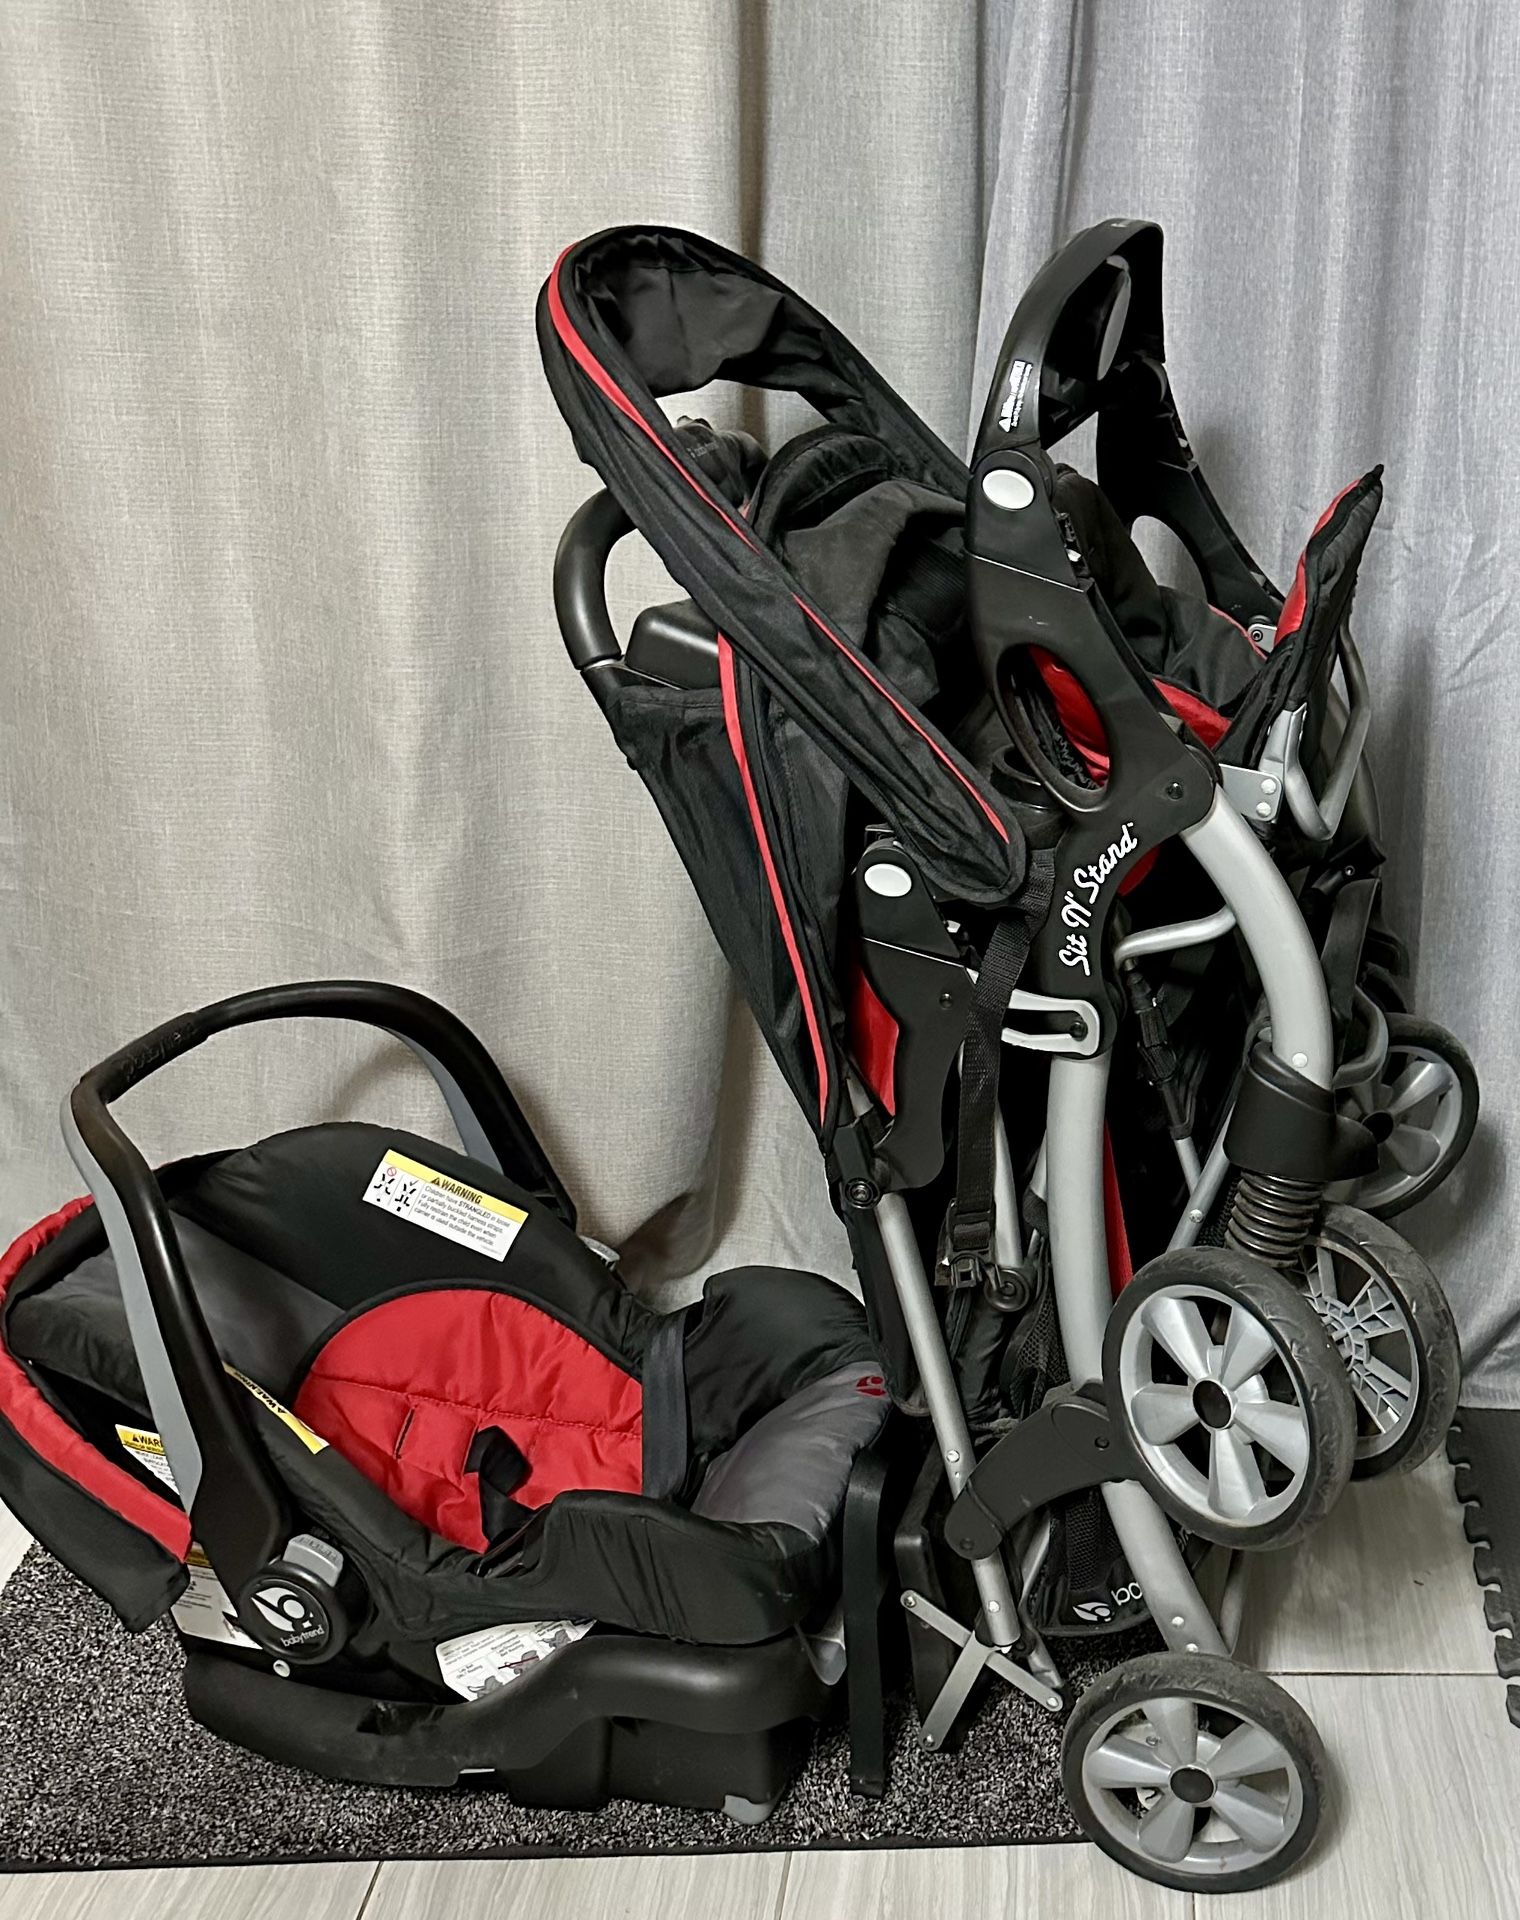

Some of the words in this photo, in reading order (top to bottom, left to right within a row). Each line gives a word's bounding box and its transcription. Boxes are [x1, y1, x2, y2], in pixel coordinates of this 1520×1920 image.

[1073, 823, 1138, 904] Stand
[1058, 933, 1091, 976] Sit
[425, 1185, 445, 1198] Children
[446, 1195, 457, 1203] have
[459, 1201, 490, 1218] STRANGLED
[441, 1179, 482, 1204] WARNING
[414, 1207, 430, 1217] carrier
[436, 1217, 448, 1225] used
[449, 1222, 467, 1233] outside
[418, 1200, 429, 1209] Fully
[430, 1206, 449, 1217] restrain
[458, 1218, 470, 1226] child
[471, 1224, 482, 1232] even
[483, 1229, 496, 1238] when
[427, 1195, 446, 1208] partially
[447, 1204, 464, 1215] buckled
[465, 1213, 487, 1225] harness
[138, 1434, 163, 1448] WAR
[280, 1623, 325, 1648] babytrend
